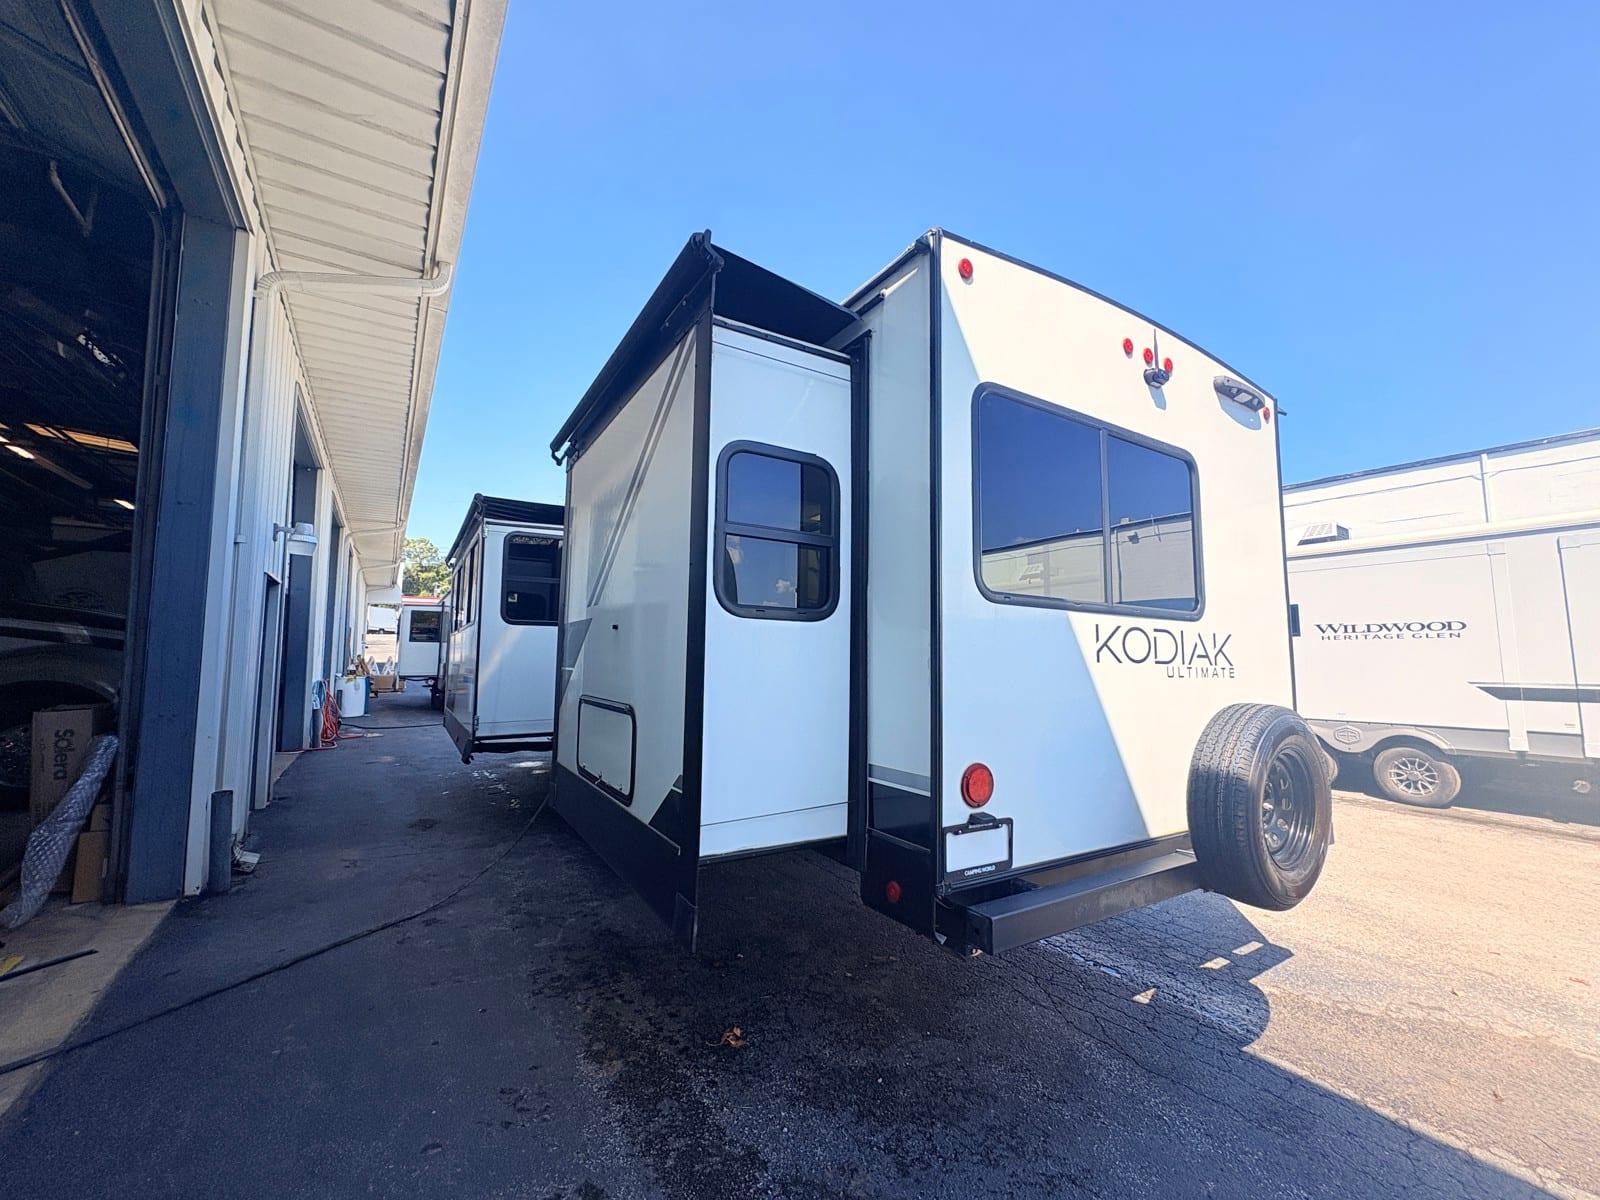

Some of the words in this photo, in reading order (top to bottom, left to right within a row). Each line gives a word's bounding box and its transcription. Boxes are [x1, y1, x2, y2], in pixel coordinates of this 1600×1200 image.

[1315, 620, 1467, 634] WILDWOOD
[1321, 633, 1404, 641] HERITAGE
[1095, 623, 1234, 667] KODIAK
[1166, 666, 1236, 679] ULTIMATE
